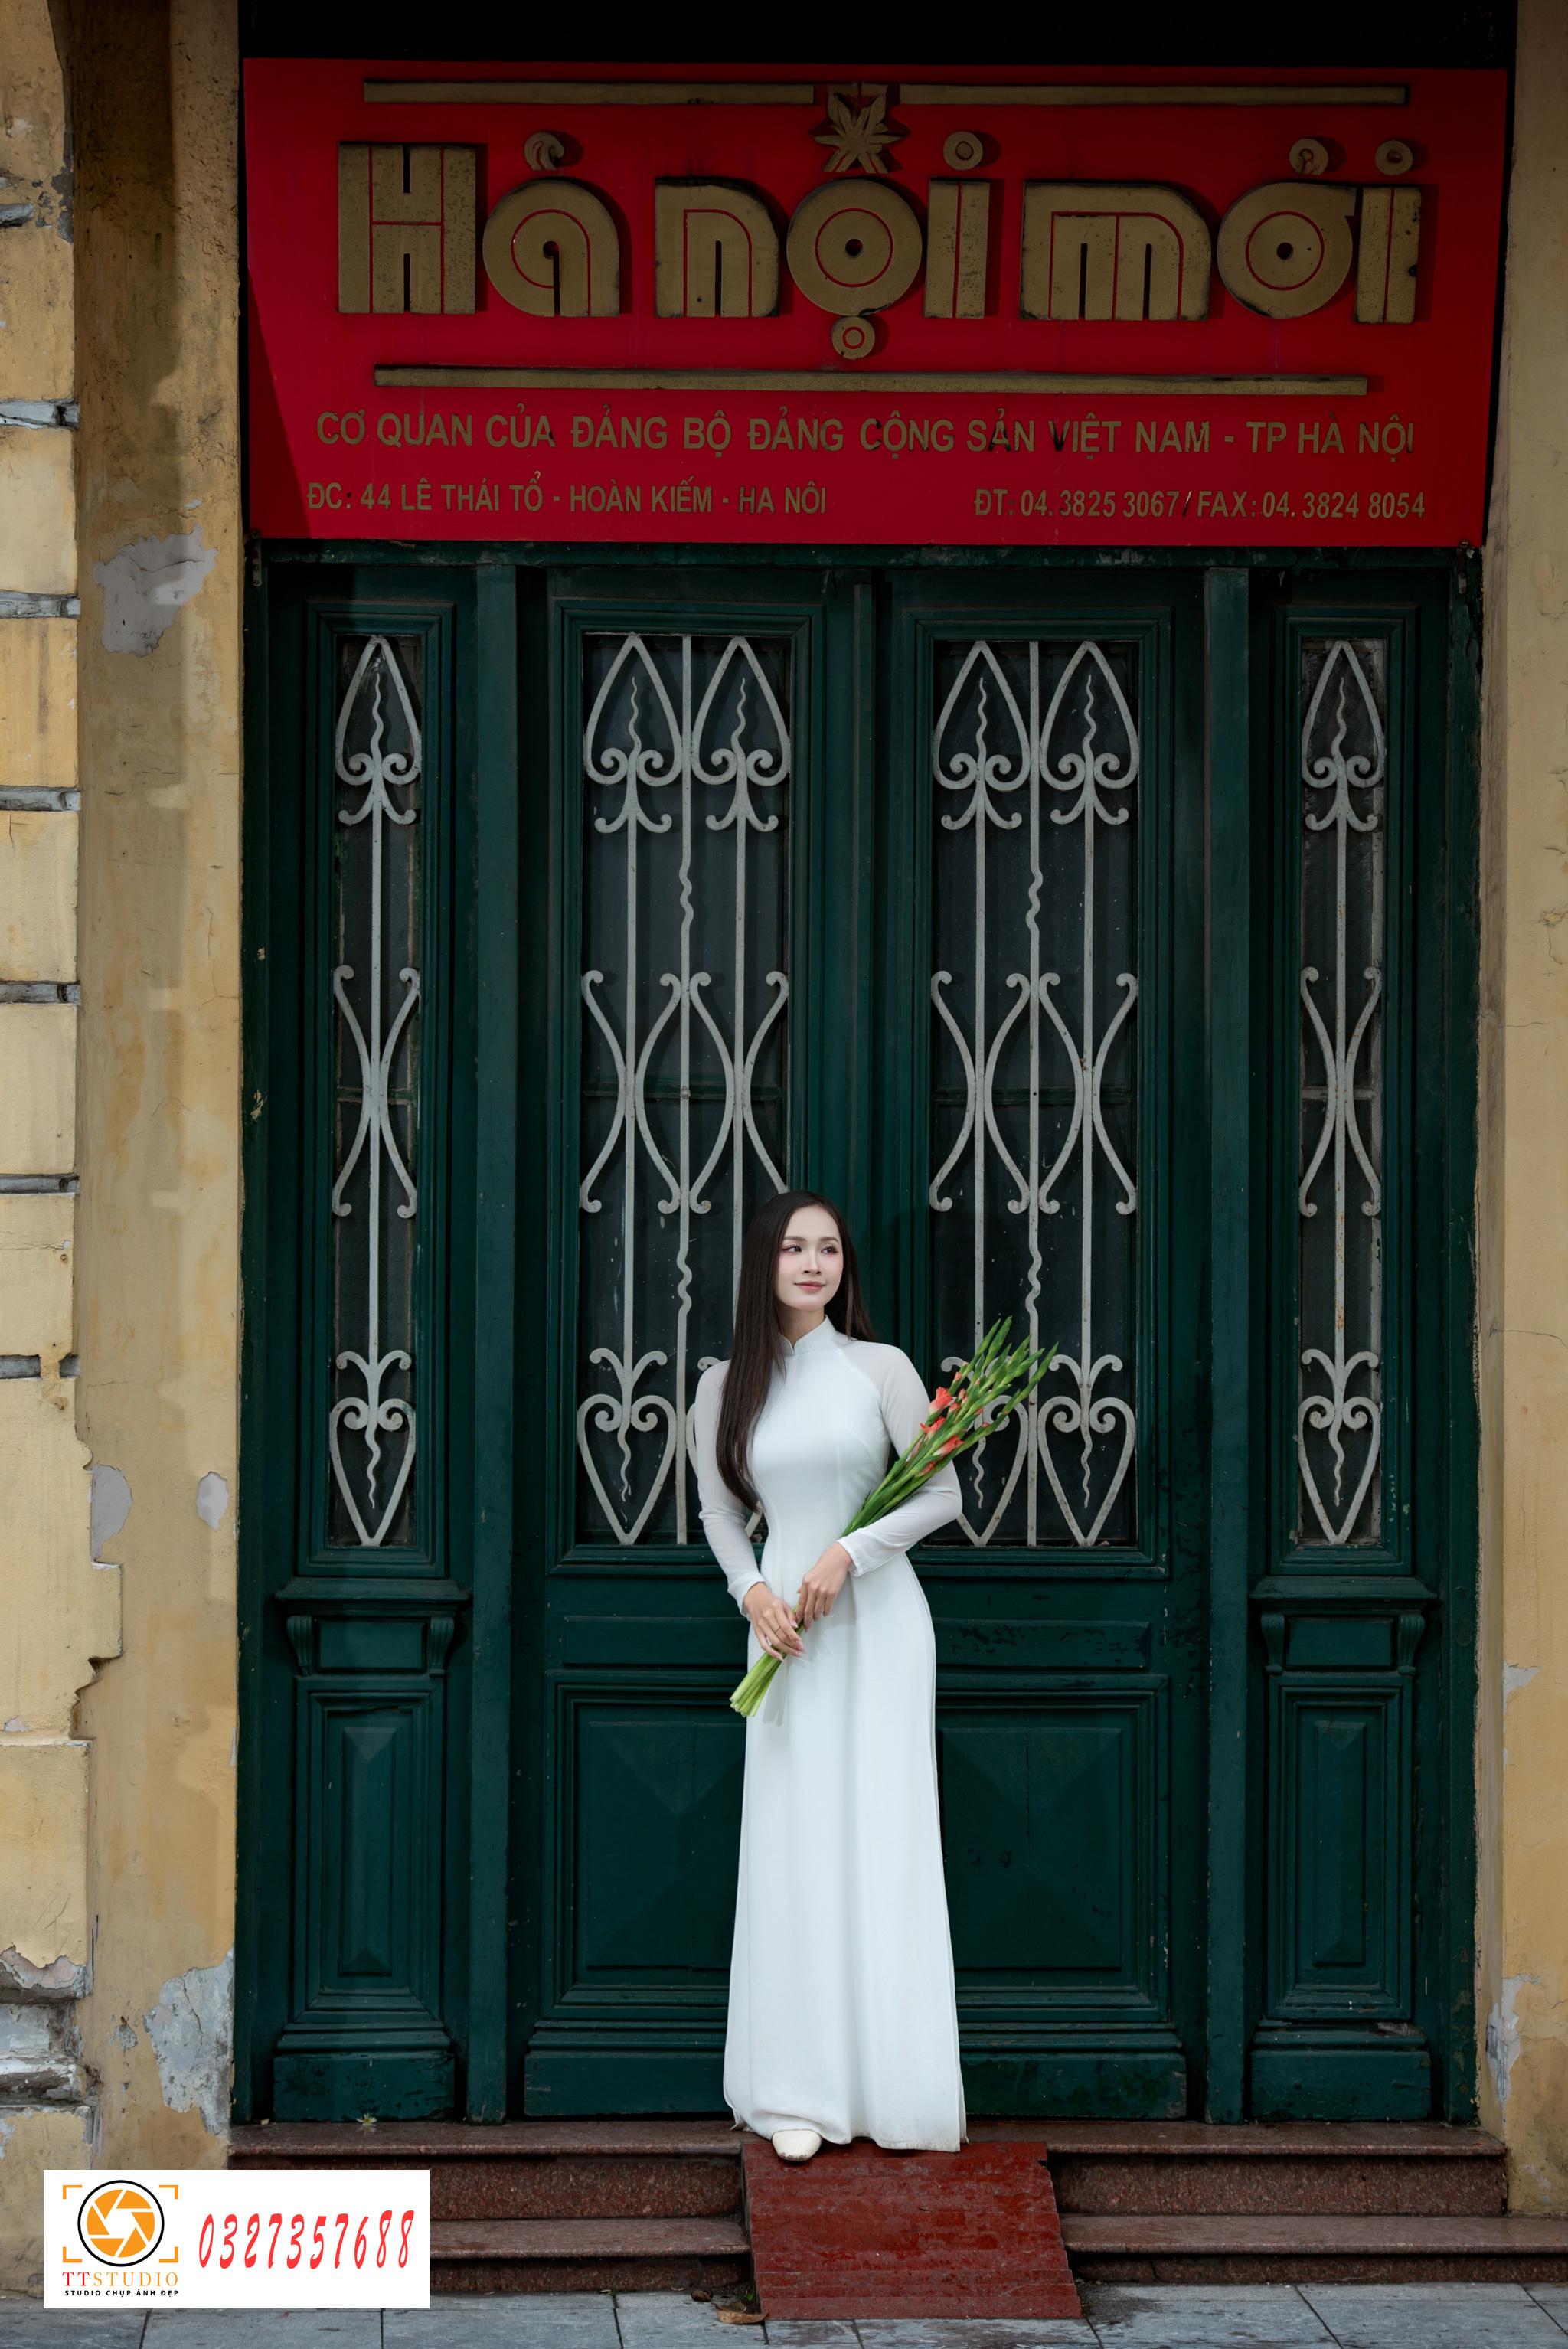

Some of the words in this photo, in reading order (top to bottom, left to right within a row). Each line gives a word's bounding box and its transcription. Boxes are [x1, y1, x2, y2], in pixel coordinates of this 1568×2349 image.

[316, 409, 366, 444] CƠ
[377, 413, 473, 448] QUAN
[485, 403, 556, 449] CỦA
[570, 404, 668, 449] ĐẢNG
[684, 410, 732, 458] BỘ
[747, 405, 844, 452] ĐẢNG
[860, 410, 956, 459] CỘNG
[966, 408, 1035, 453] SẢN
[1047, 412, 1122, 460] VIỆT
[1135, 420, 1210, 453] NAM
[1246, 421, 1287, 453] TP
[1298, 411, 1345, 454] HÀ
[1358, 413, 1414, 462] NỘI
[306, 482, 352, 510] ĐC:
[360, 483, 392, 510] 44
[401, 477, 433, 511] LÊ
[440, 478, 500, 511] THÁI
[508, 470, 544, 511] TỔ
[570, 478, 642, 512] HOÀN
[651, 475, 713, 513] KIẾM
[974, 488, 1015, 515] ĐT:
[1059, 490, 1116, 518] 3825
[1302, 491, 1359, 518] 3824
[1368, 492, 1425, 519] 8054
